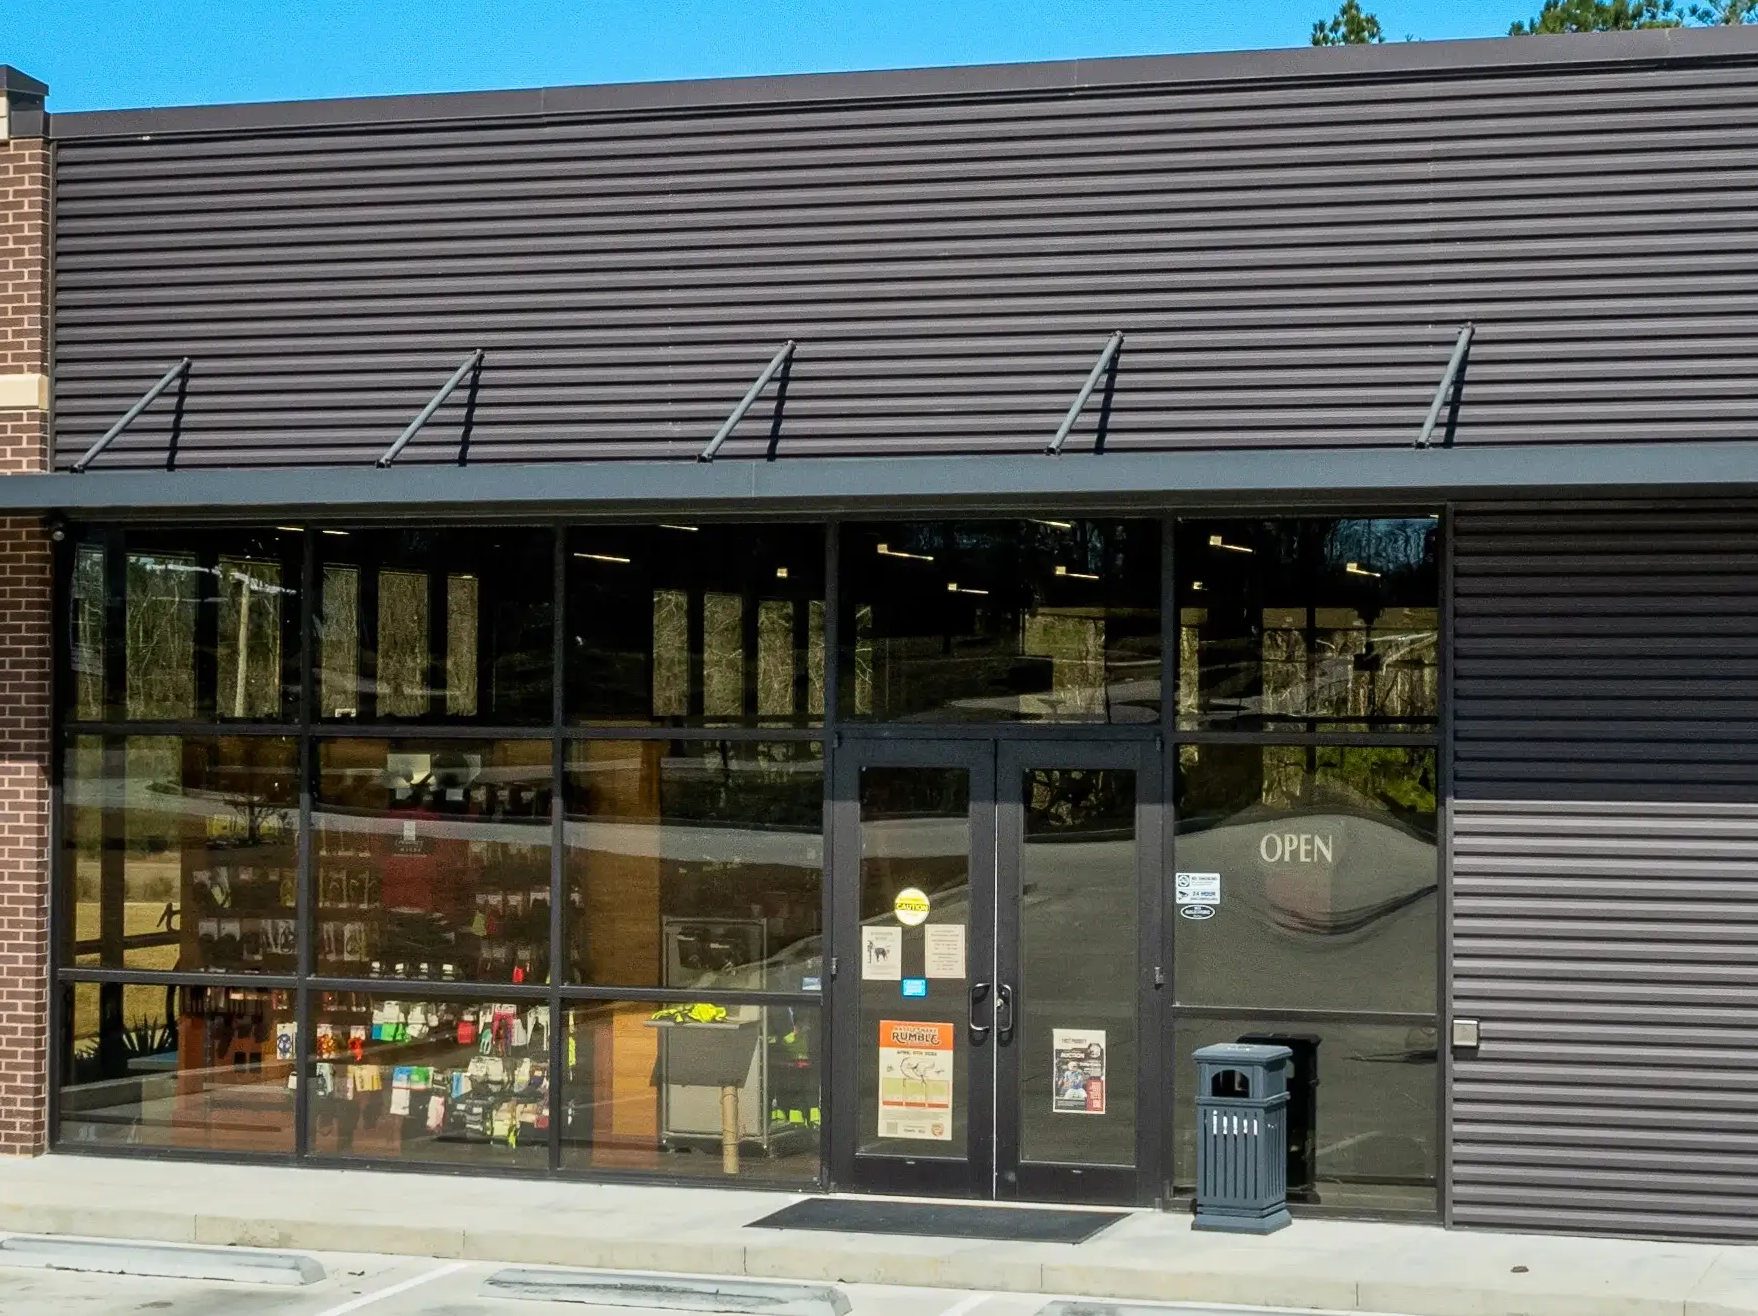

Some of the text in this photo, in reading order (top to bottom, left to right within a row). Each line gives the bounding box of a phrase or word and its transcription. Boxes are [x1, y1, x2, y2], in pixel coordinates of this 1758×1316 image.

[1260, 833, 1333, 862] OPEN
[895, 903, 930, 912] CAUTION
[892, 1031, 941, 1046] RUMBLE
